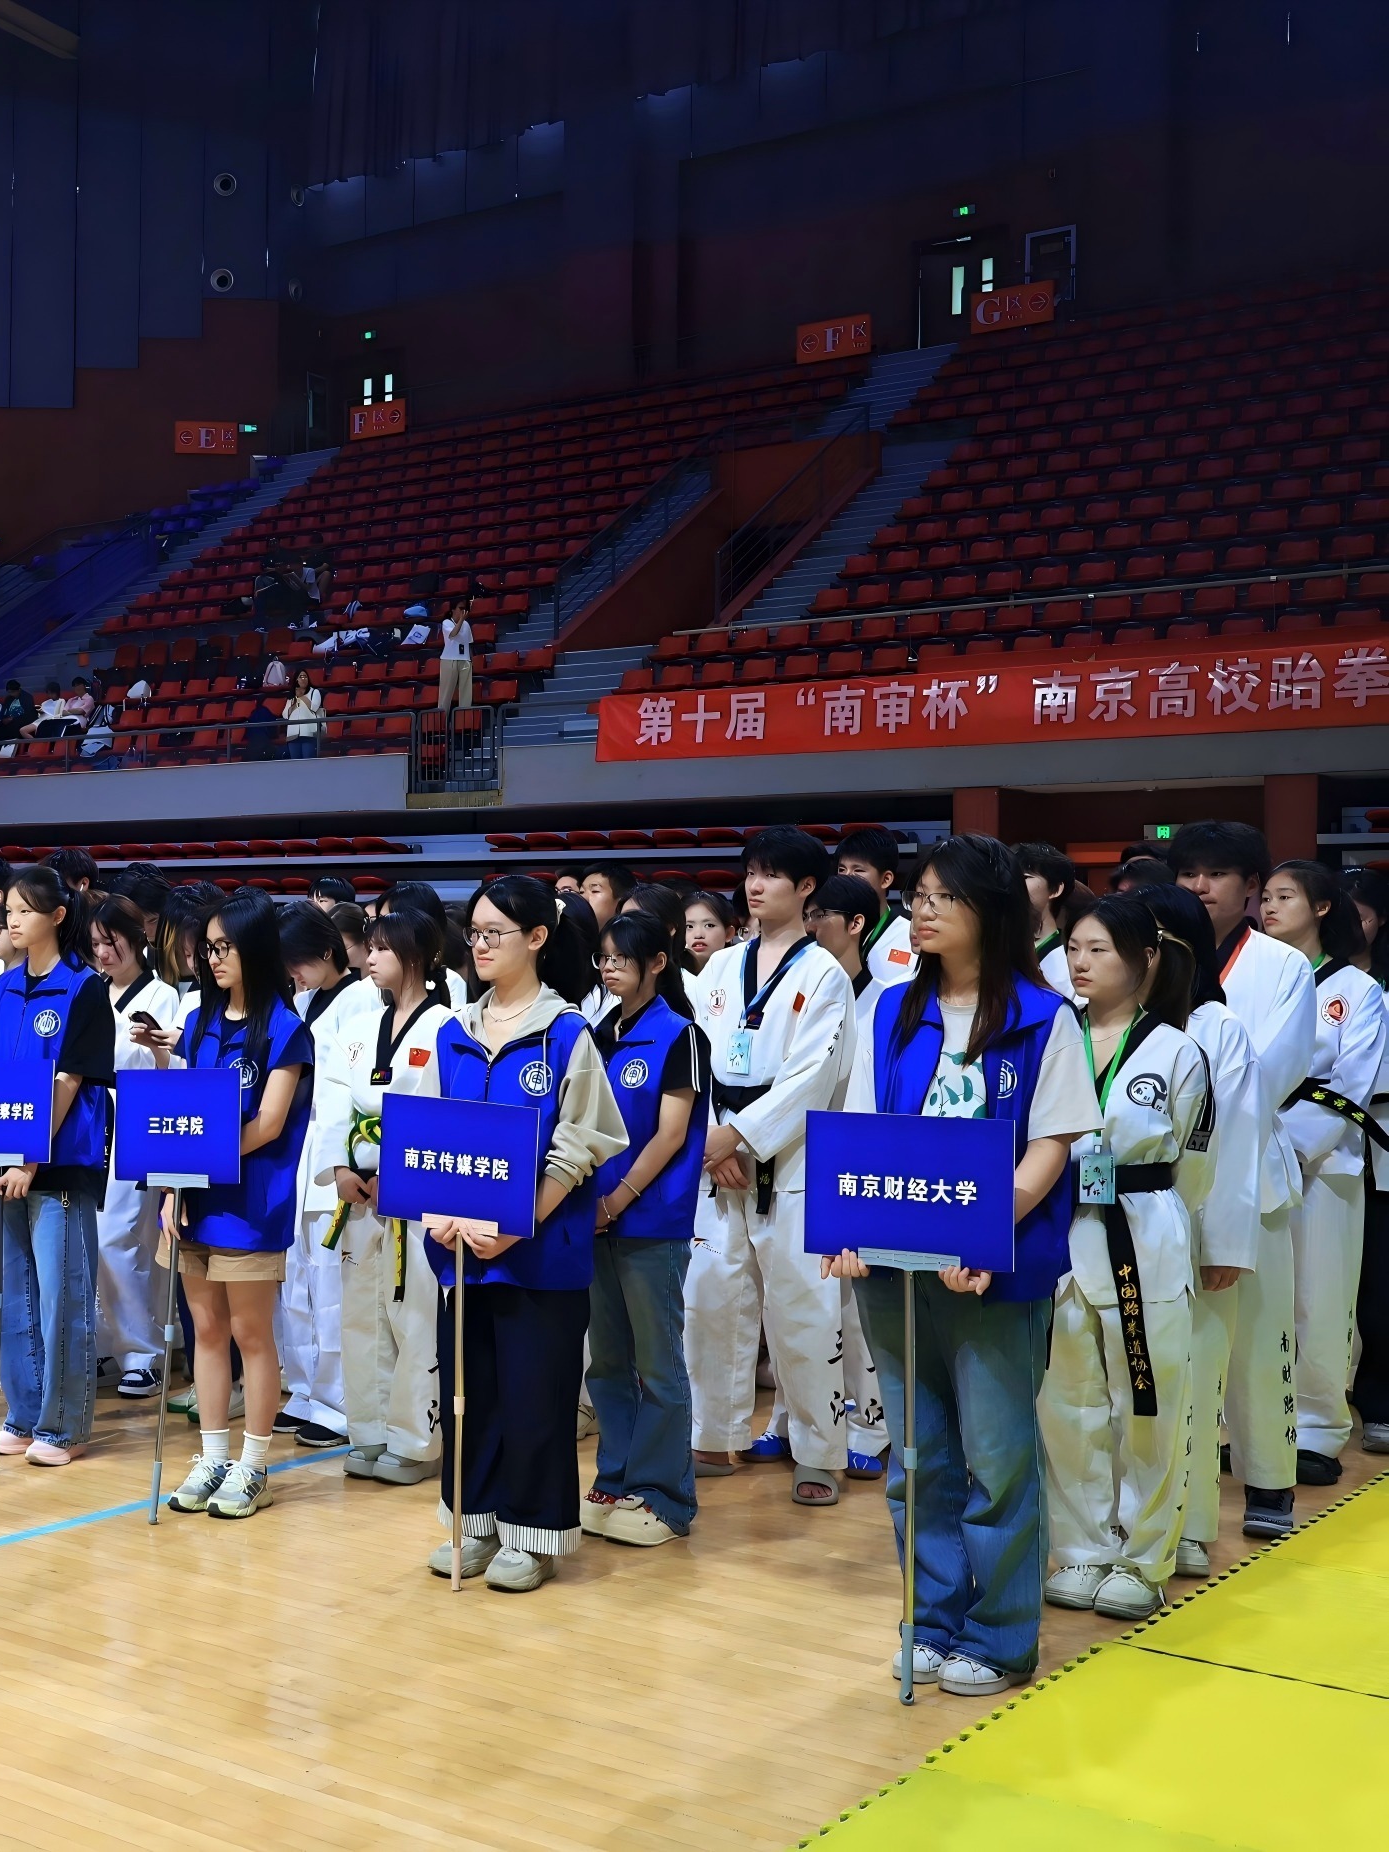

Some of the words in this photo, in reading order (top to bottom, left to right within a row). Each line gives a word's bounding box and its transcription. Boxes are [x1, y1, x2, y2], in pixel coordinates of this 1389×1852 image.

[147, 1116, 203, 1135] 三江学院
[404, 1147, 509, 1181] 南京传媒学院
[837, 1172, 977, 1206] 南京财经大学
